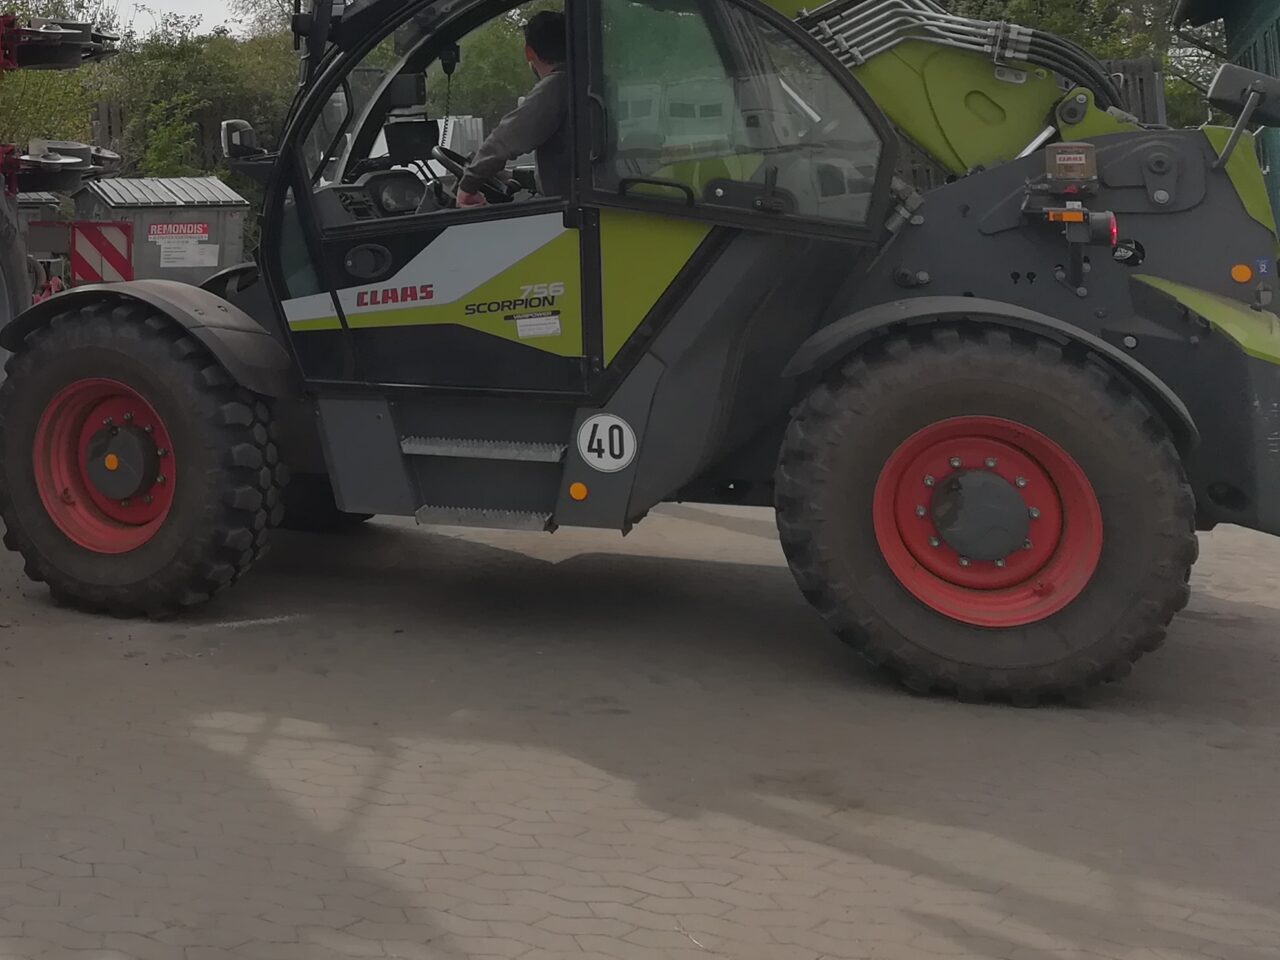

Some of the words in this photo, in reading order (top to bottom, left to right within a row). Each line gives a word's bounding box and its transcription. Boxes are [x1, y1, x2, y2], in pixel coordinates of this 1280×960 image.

[150, 224, 203, 235] REMONDIS
[356, 284, 433, 307] CLAAS
[519, 282, 565, 299] 756
[464, 296, 555, 315] SCORPION
[587, 423, 625, 460] 40
